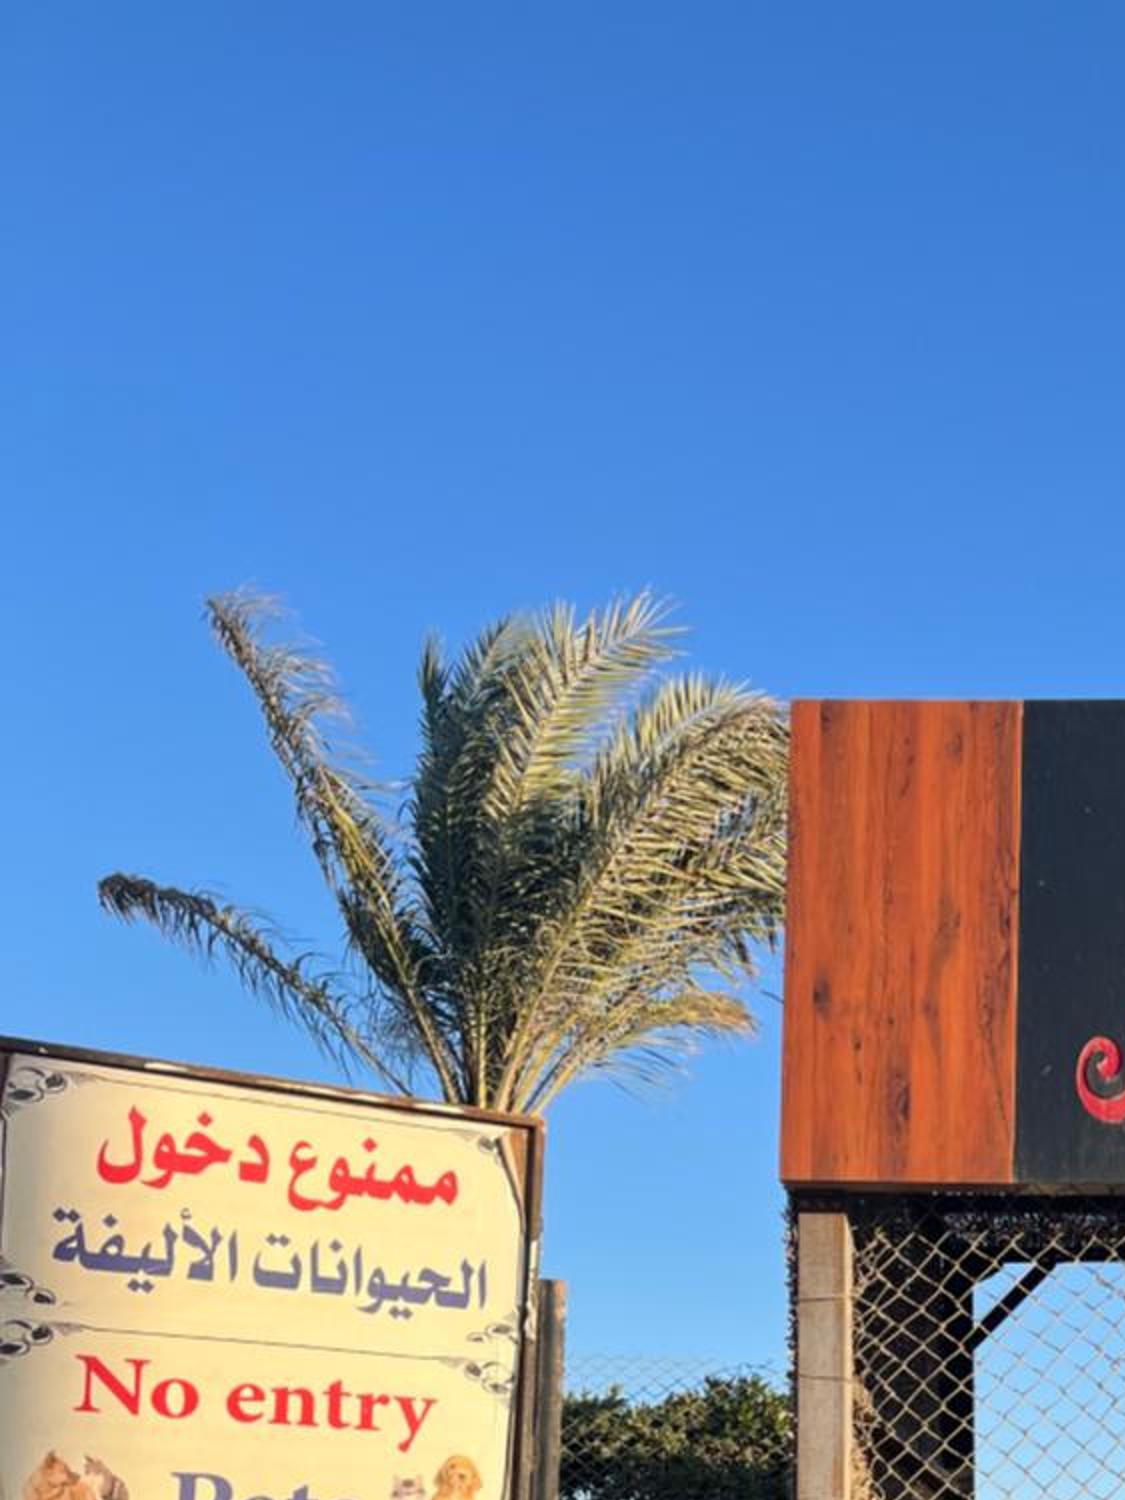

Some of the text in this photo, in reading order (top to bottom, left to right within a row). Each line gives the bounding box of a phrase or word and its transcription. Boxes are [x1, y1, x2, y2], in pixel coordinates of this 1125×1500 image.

[96, 1105, 460, 1213] ممنوع دخول
[51, 1207, 489, 1320] الحيوانات الأليفة
[73, 1353, 439, 1453] No entry
